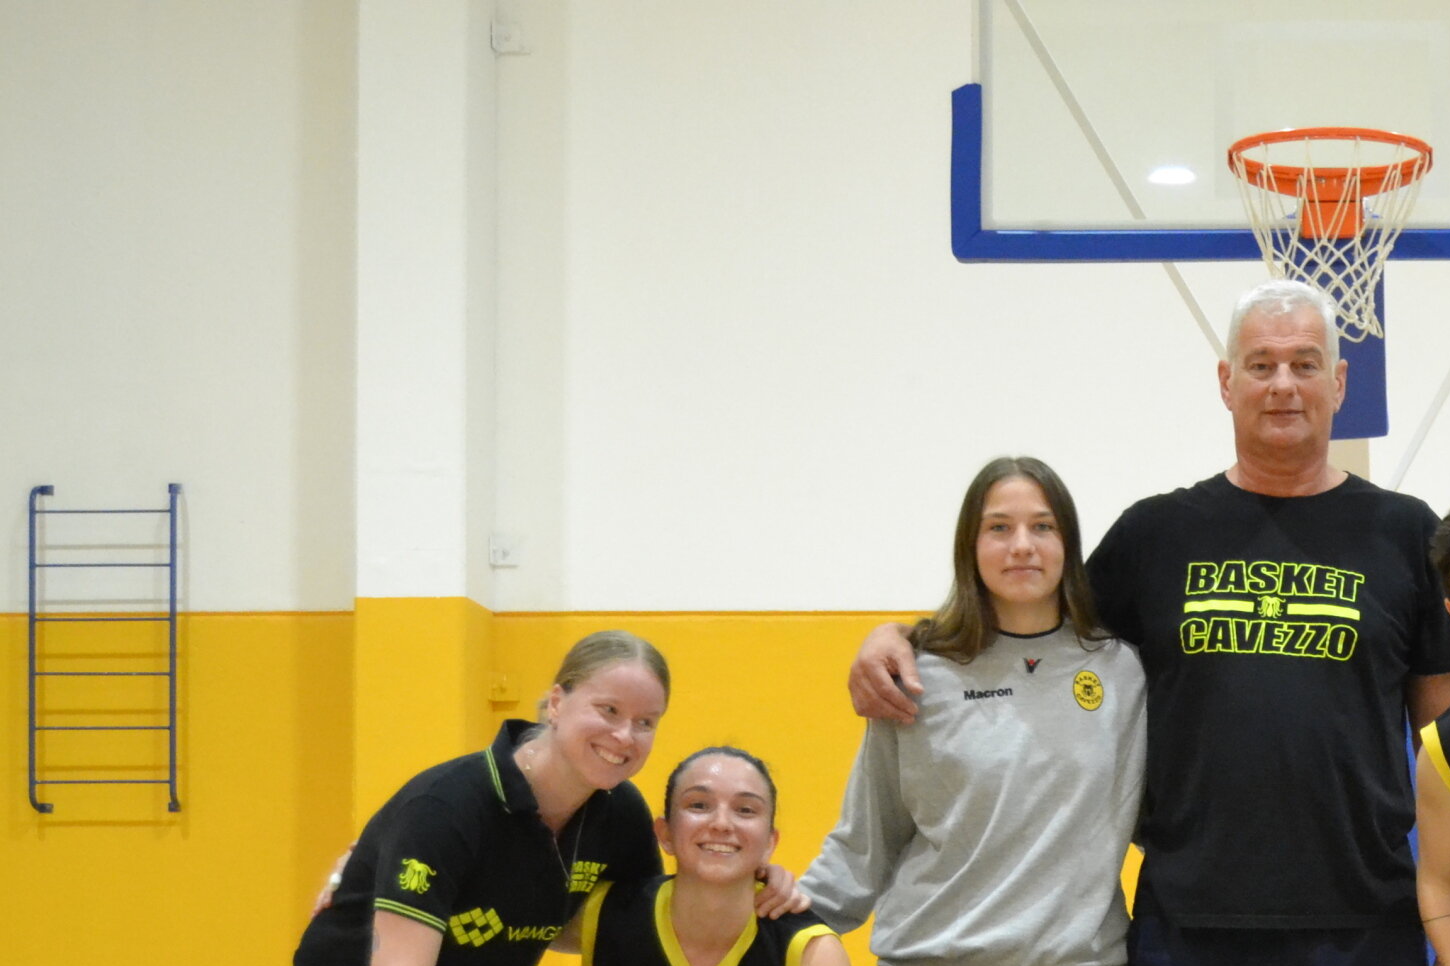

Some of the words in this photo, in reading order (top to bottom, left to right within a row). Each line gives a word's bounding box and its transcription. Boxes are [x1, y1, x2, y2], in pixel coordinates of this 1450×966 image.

[1186, 560, 1365, 602] BASKET
[1180, 617, 1358, 661] CAVEZZO
[963, 686, 1013, 701] Macron
